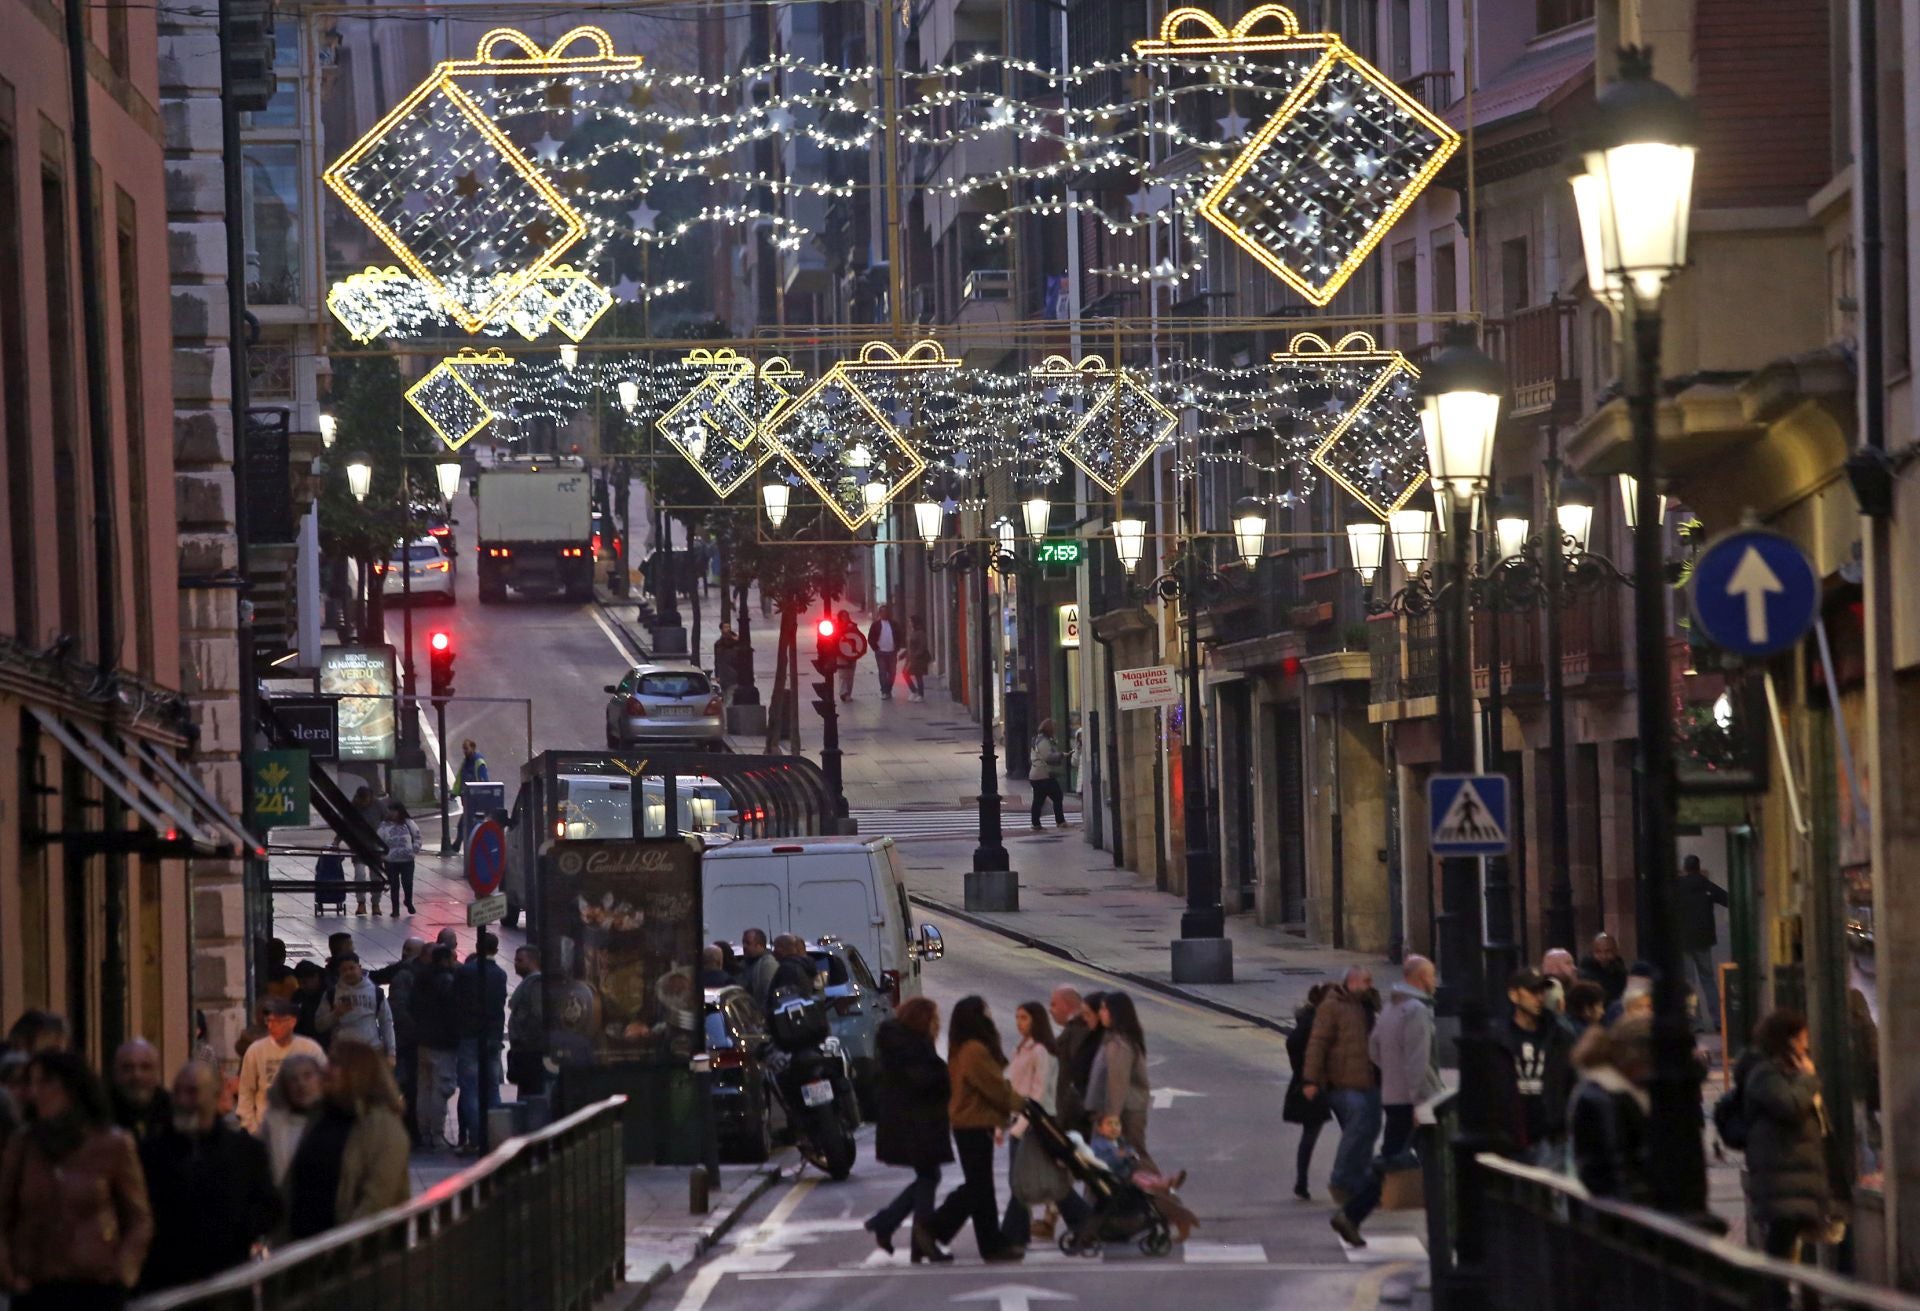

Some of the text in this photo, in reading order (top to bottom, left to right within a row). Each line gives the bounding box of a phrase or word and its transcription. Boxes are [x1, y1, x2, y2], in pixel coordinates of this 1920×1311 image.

[1068, 623, 1079, 636] C
[367, 660, 385, 668] CON
[256, 793, 295, 815] 24h
